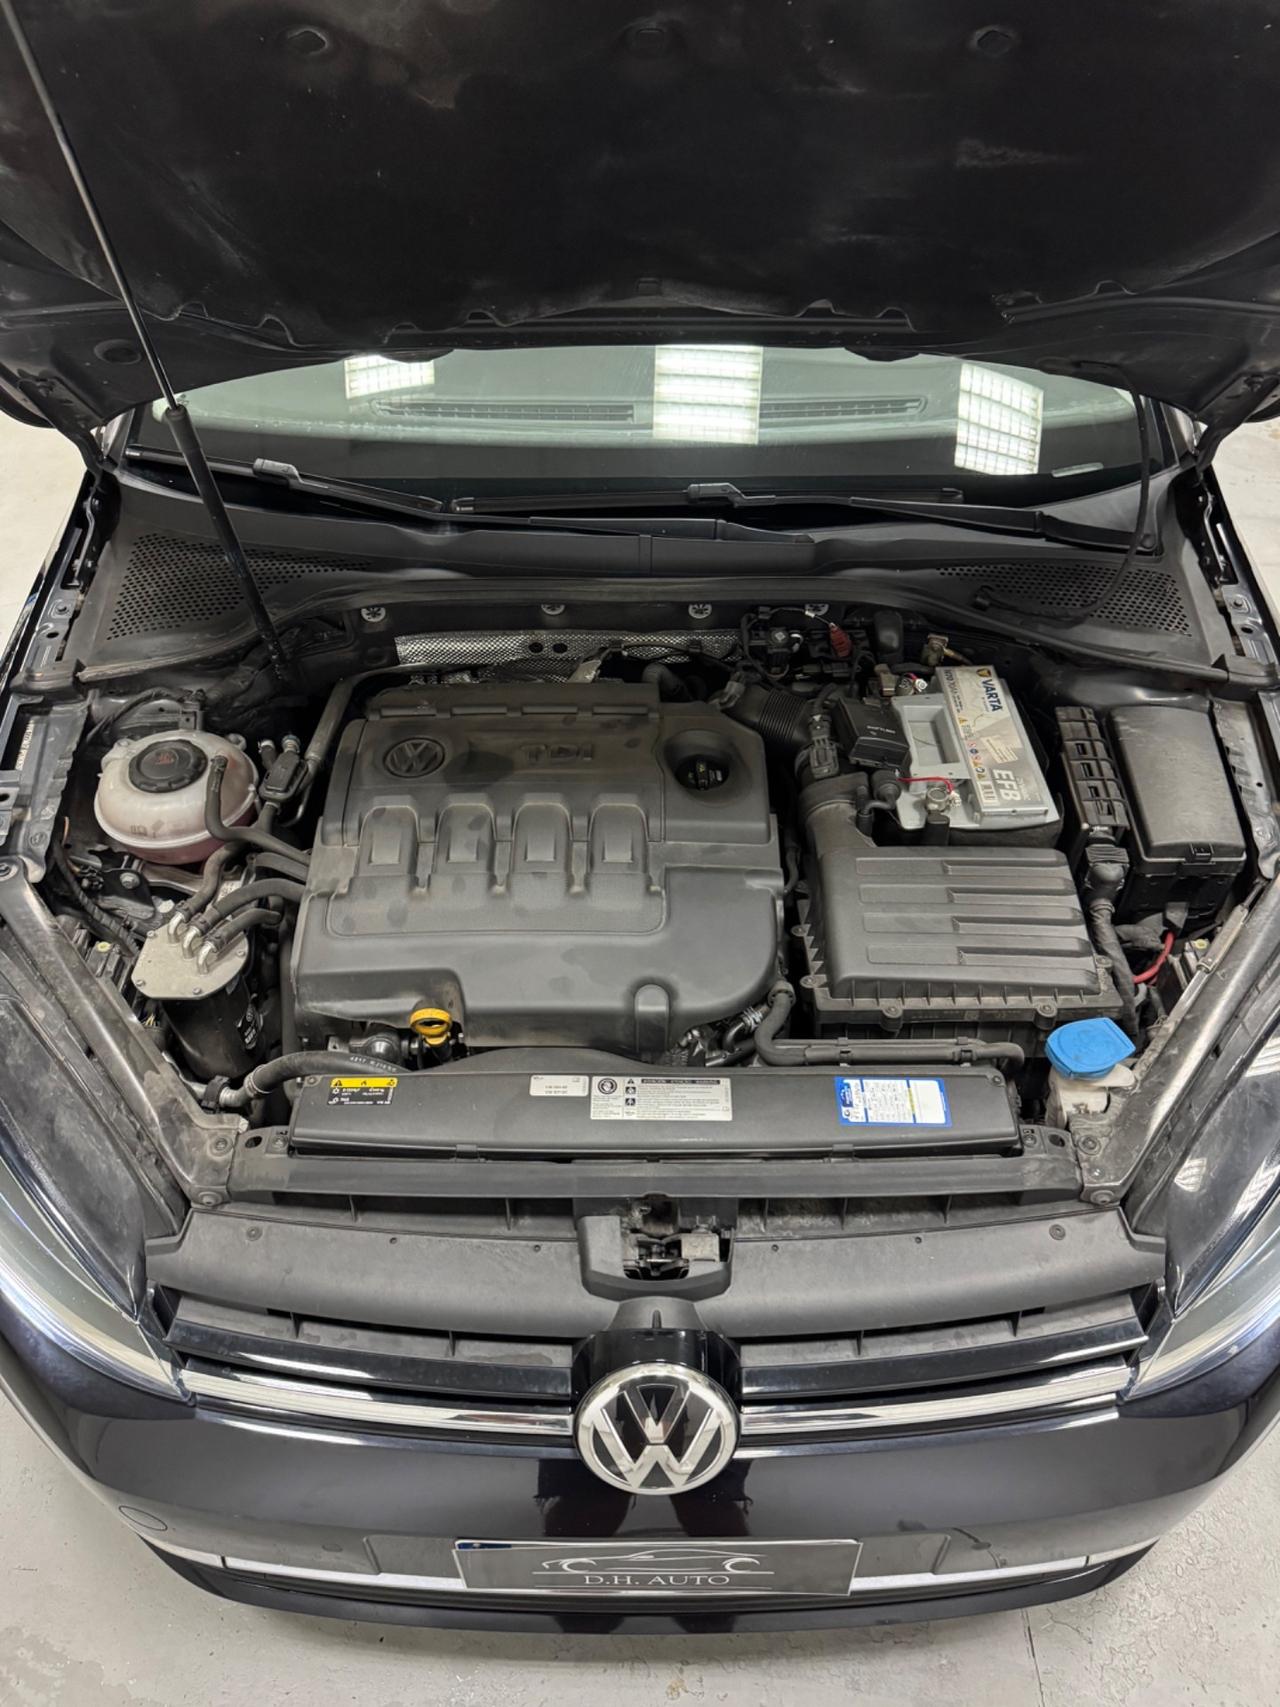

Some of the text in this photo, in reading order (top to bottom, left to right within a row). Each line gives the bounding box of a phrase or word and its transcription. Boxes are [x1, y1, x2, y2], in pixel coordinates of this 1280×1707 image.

[981, 679, 1003, 712] VARTA
[520, 743, 593, 764] TDI
[992, 768, 1021, 801] EFB
[580, 1366, 734, 1492] VW
[584, 1575, 730, 1585] D.H. AUTO
